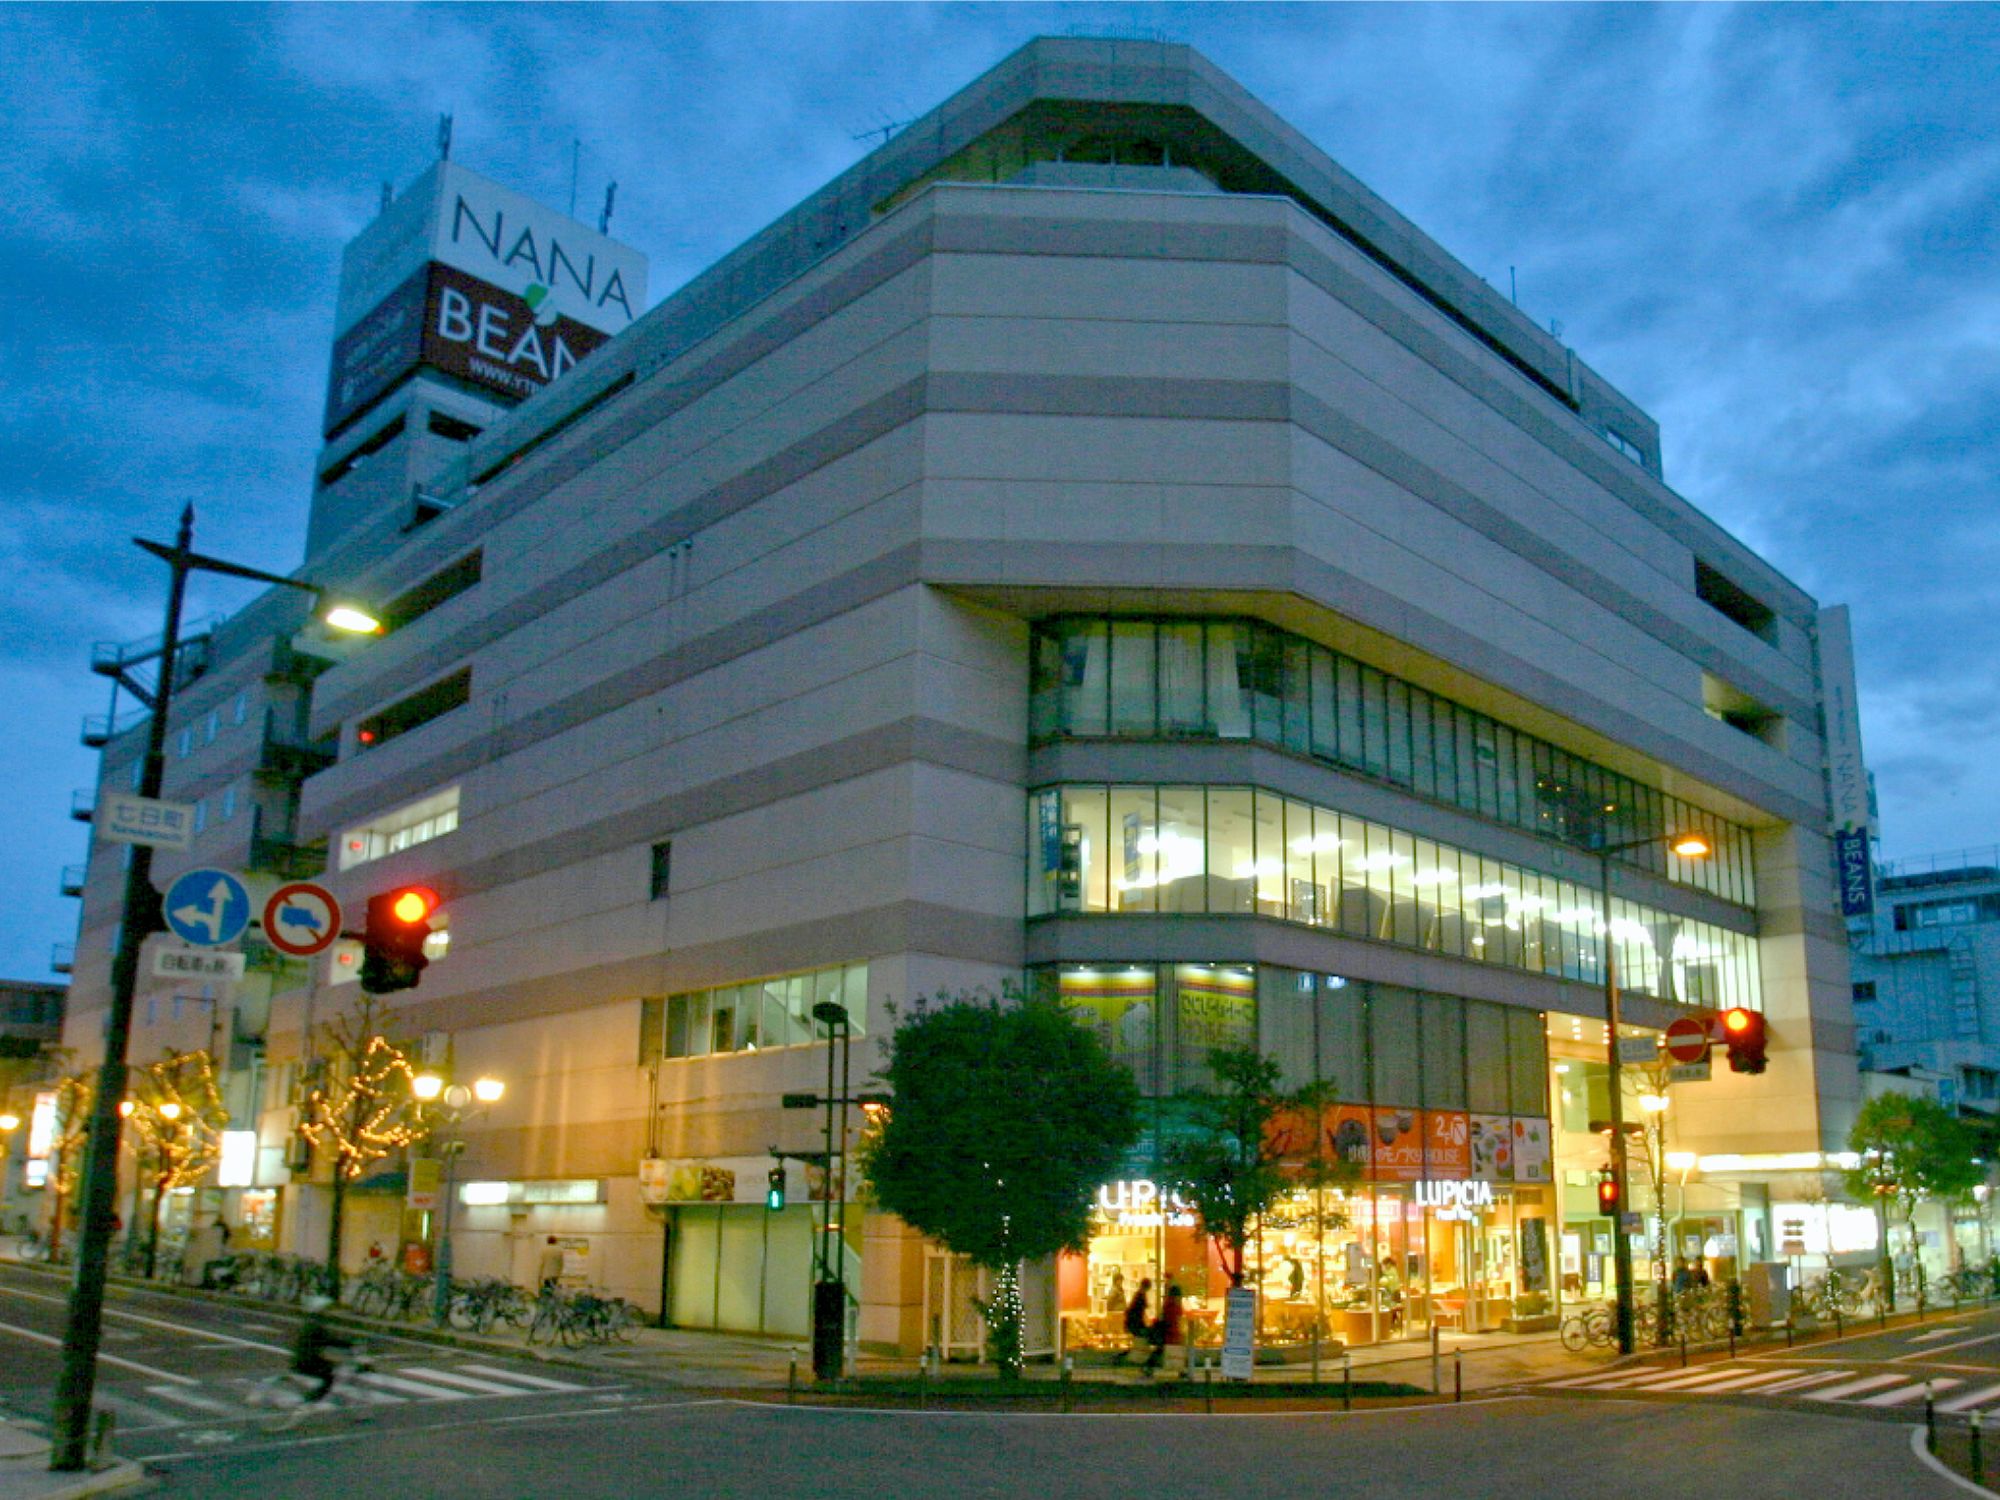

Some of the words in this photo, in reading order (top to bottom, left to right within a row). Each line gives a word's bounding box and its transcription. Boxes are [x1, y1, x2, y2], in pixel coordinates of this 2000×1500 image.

[451, 193, 635, 322] NANA
[1836, 751, 1857, 813] NANA
[1843, 838, 1865, 905] BEANS
[1415, 1179, 1492, 1207] LUPICIA
